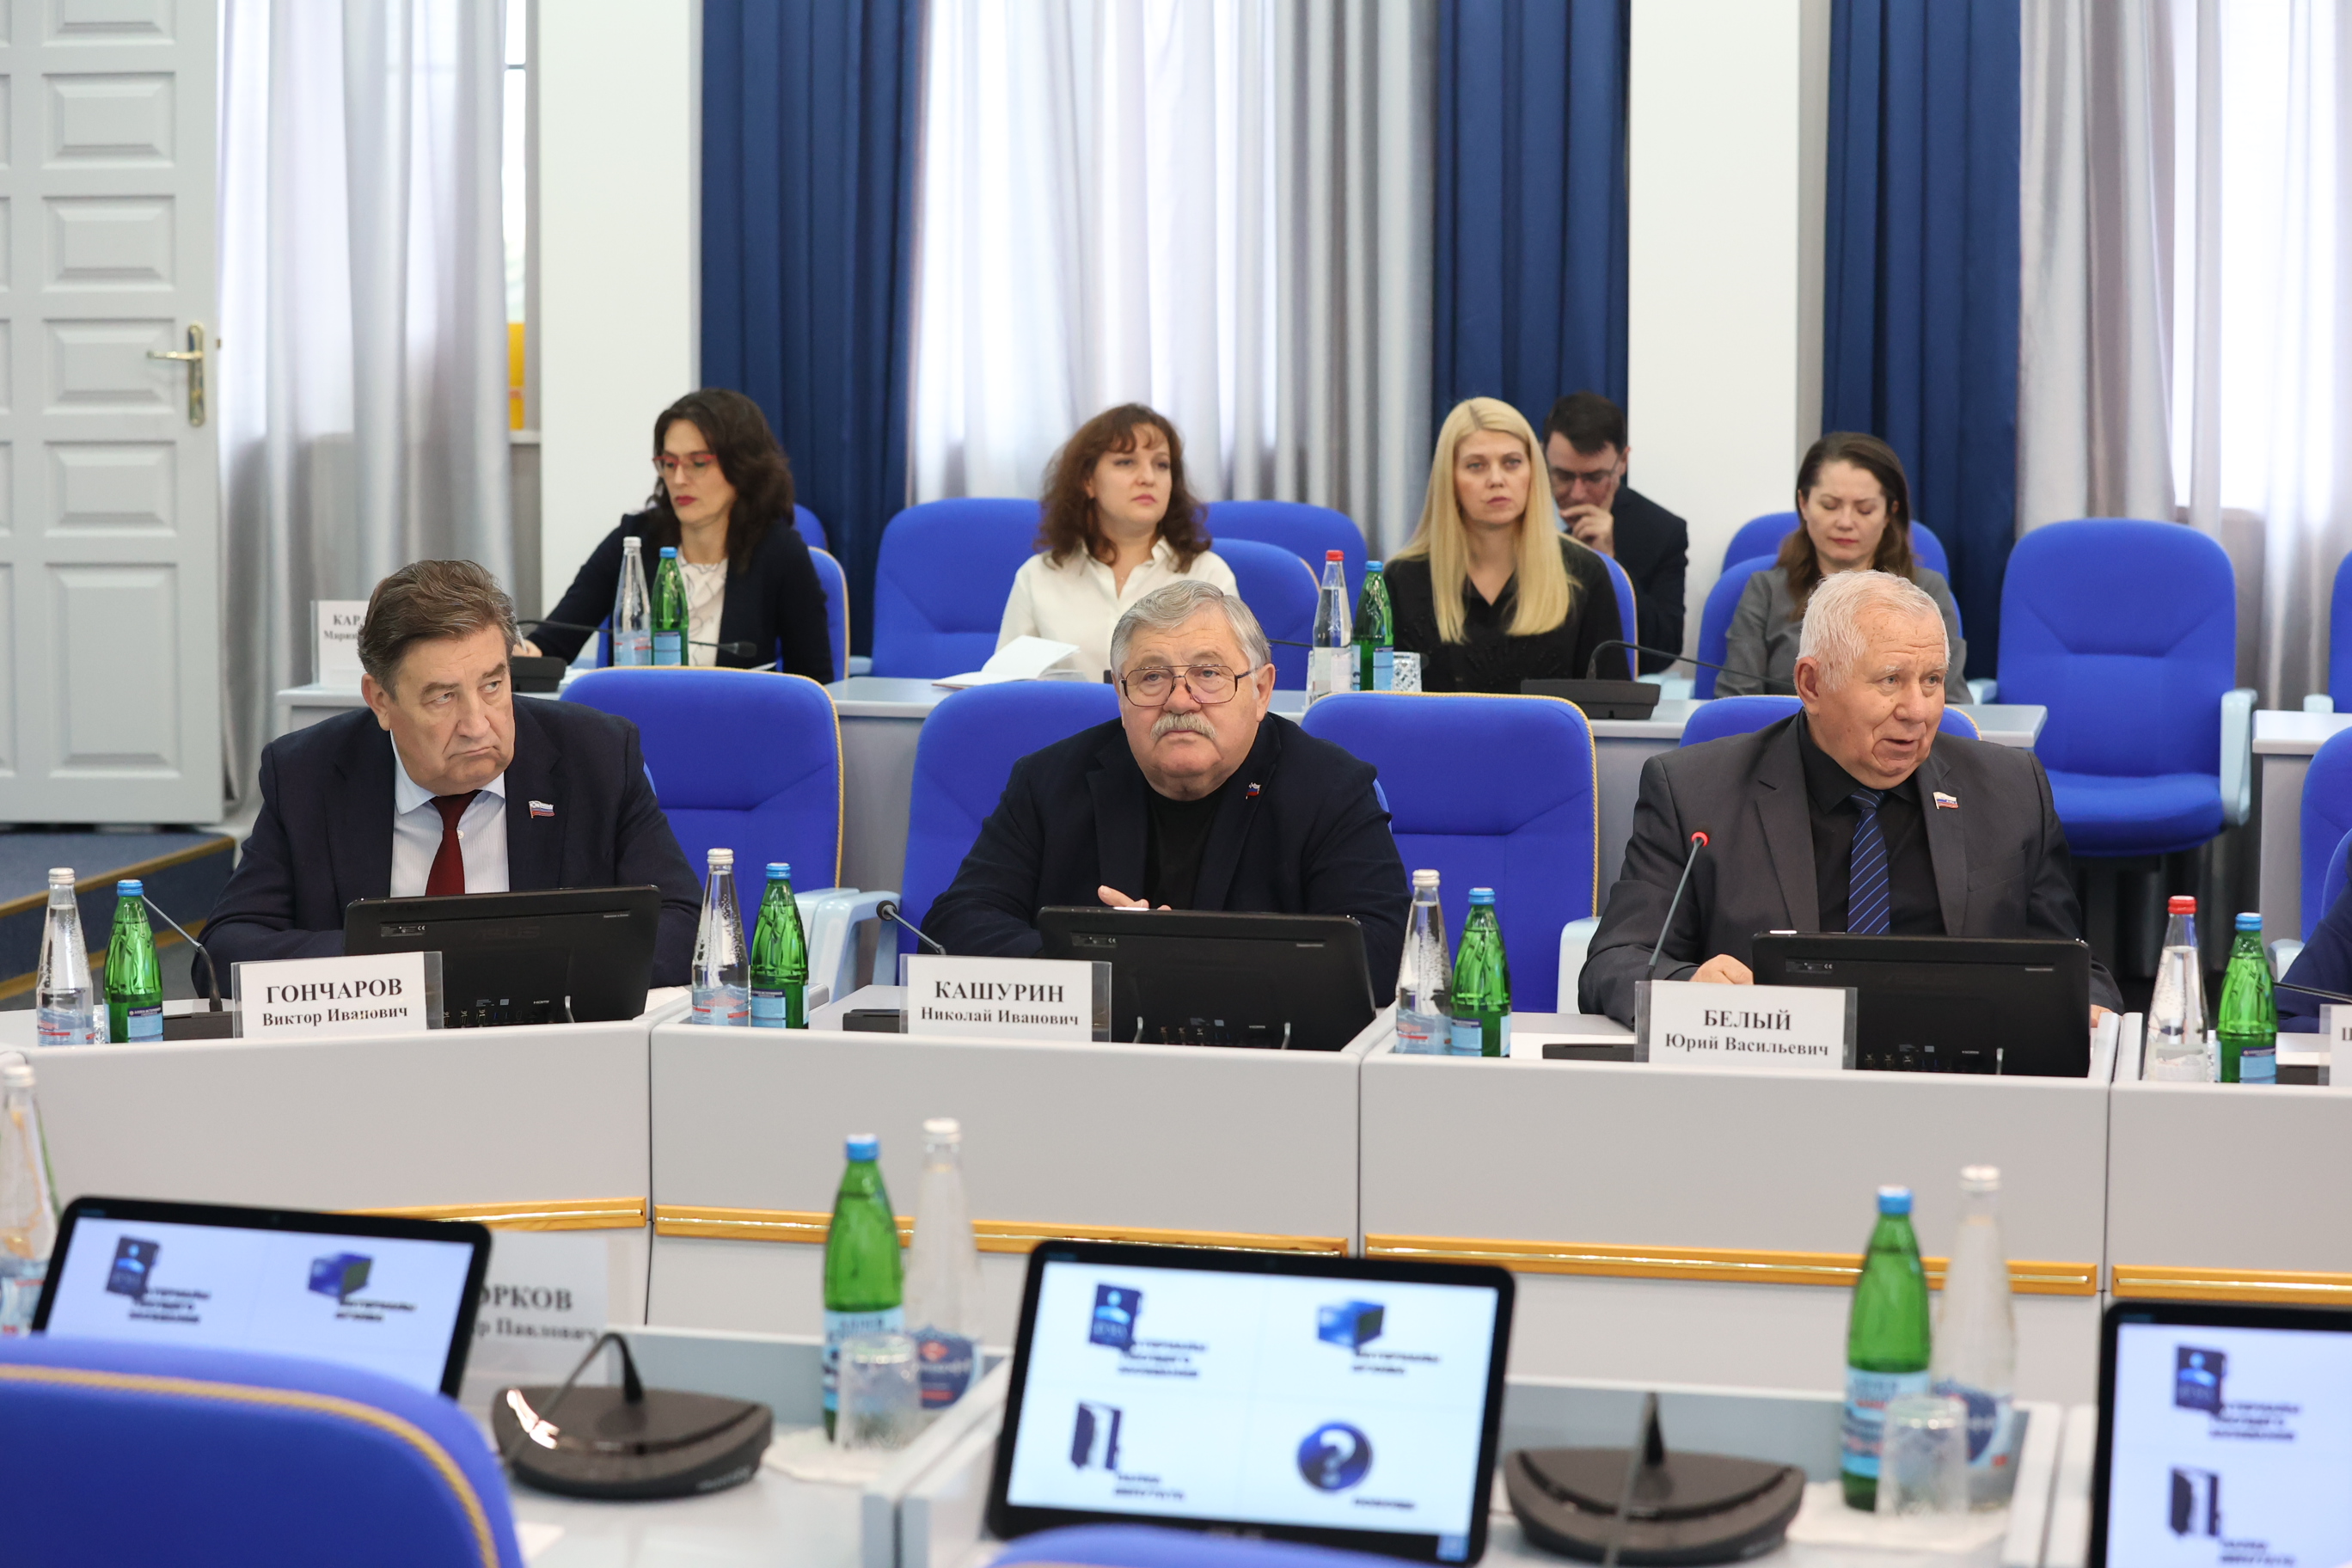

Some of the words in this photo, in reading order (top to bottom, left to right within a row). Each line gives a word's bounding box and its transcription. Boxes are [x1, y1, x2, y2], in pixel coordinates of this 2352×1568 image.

[266, 977, 403, 1004] ГОНЧАРОВ
[934, 980, 1064, 1002] КАШУРИН
[262, 1011, 322, 1026] Виктор
[328, 1007, 408, 1022] Иванович
[921, 1007, 992, 1023] Николай
[998, 1009, 1079, 1026] Иванович
[1703, 1008, 1792, 1031] БЕЛЫЙ
[1665, 1033, 1718, 1052] Юрий
[1725, 1036, 1829, 1056] Васильевич
